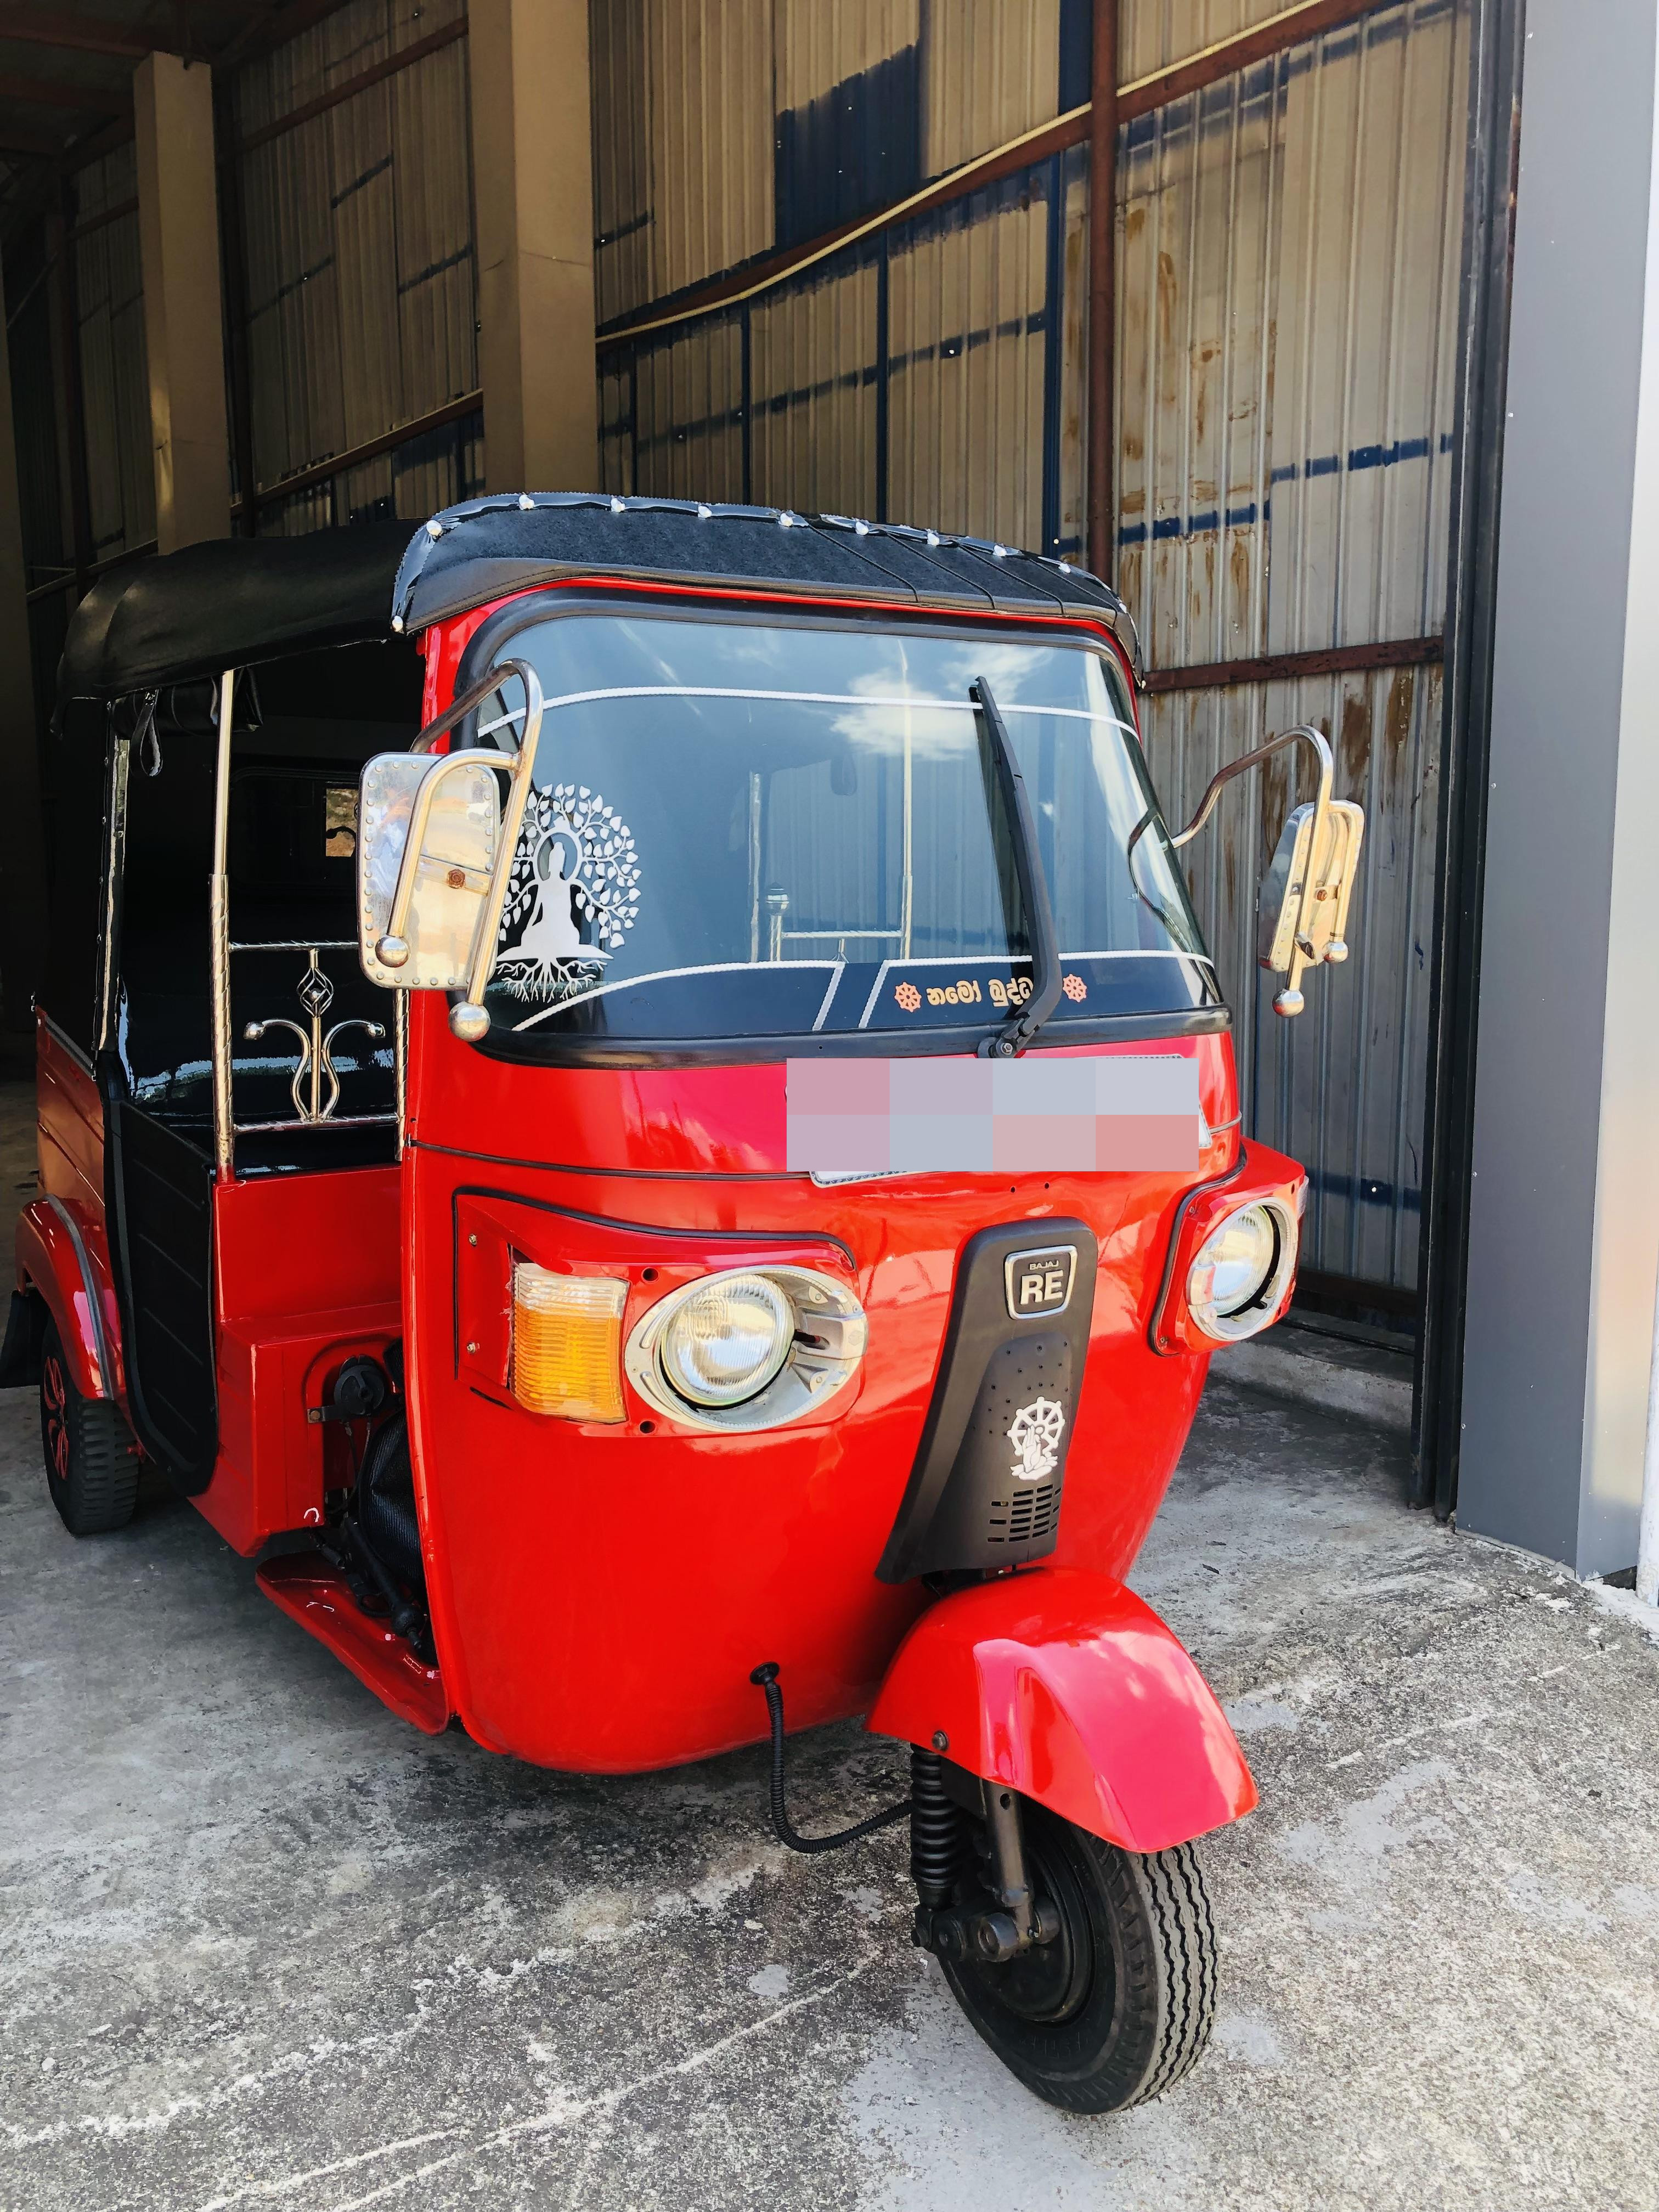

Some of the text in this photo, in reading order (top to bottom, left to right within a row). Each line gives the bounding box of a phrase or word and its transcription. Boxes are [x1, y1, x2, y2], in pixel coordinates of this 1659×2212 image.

[926, 977, 1034, 1007] නමෝ බුද්ධ
[1029, 1260, 1059, 1271] BAJAJ
[1020, 1269, 1064, 1305] RE
